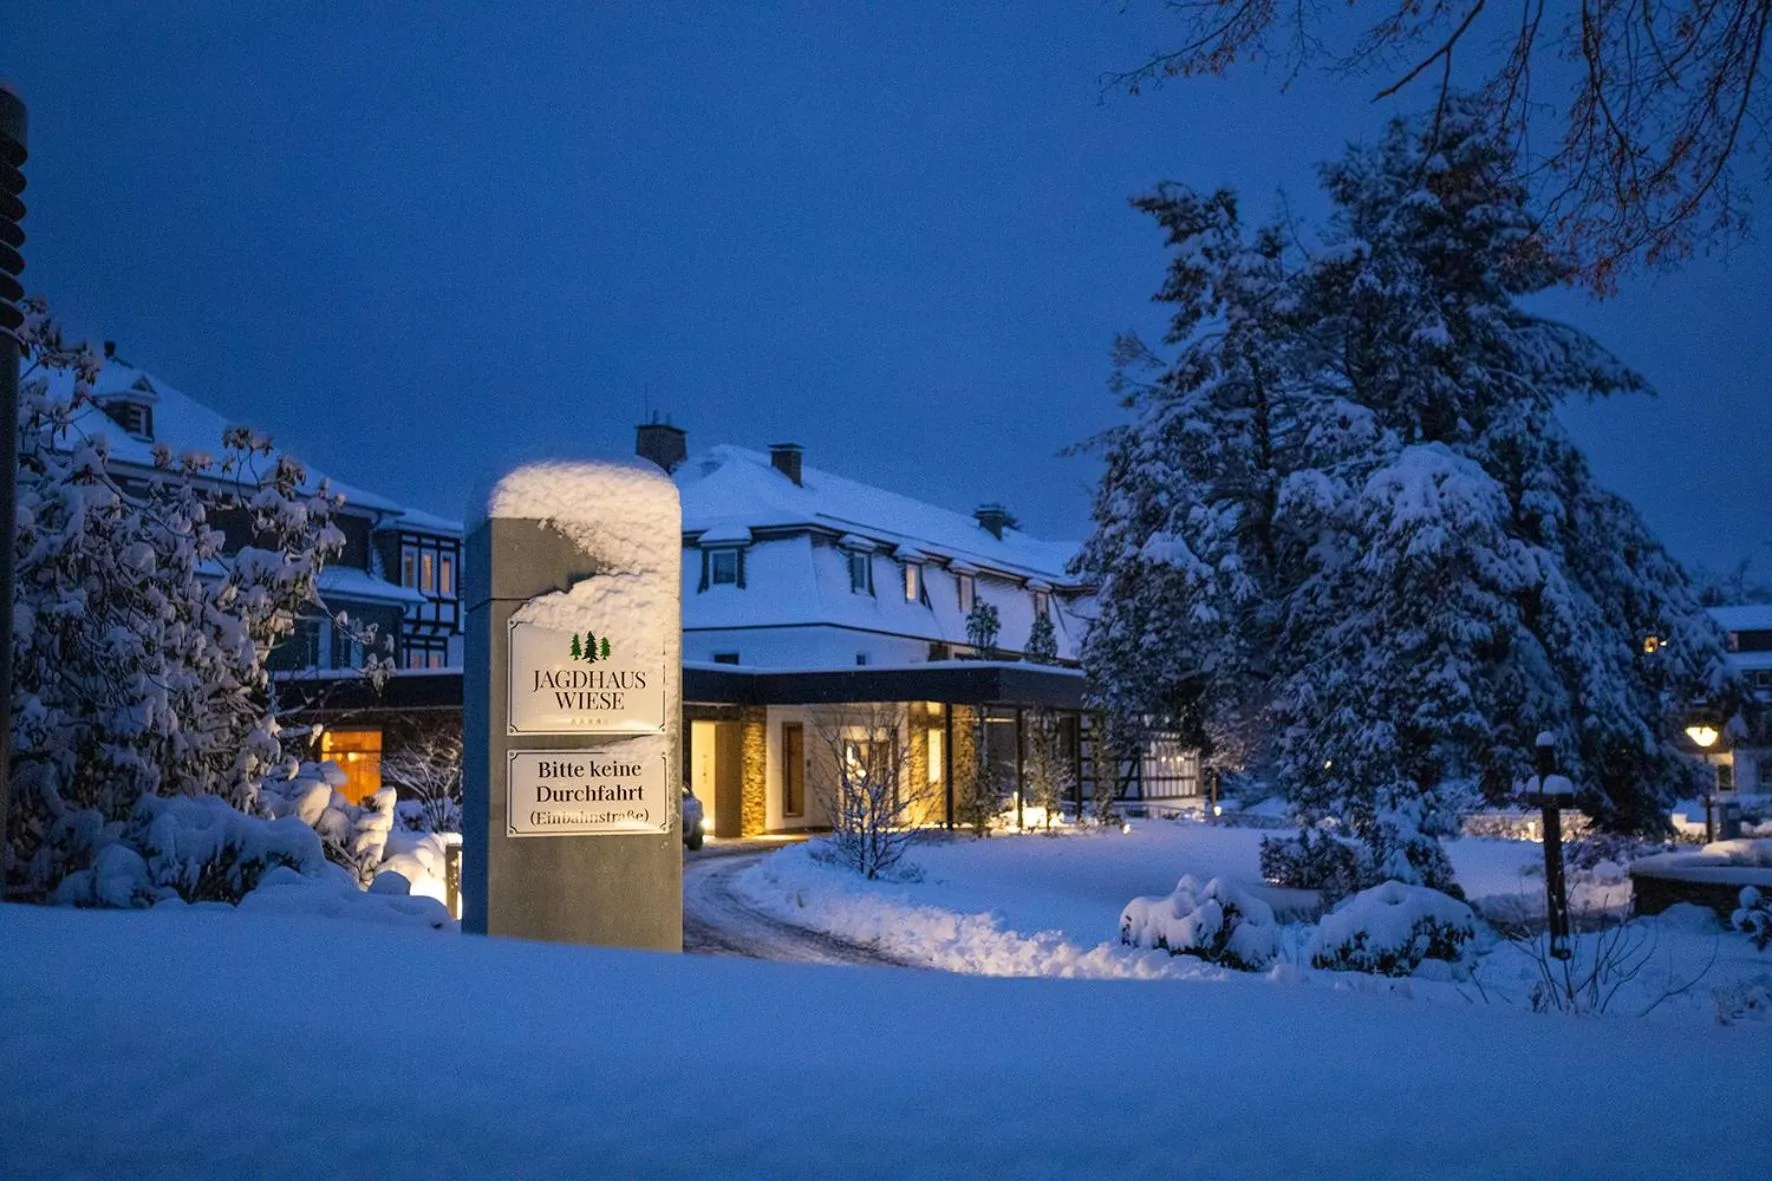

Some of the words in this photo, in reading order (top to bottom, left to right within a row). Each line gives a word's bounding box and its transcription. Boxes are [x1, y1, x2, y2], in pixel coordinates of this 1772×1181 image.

[533, 670, 646, 692] JAGDHAUS
[555, 691, 625, 710] WIESE
[538, 761, 584, 778] Bitte
[590, 760, 642, 777] keine
[536, 785, 645, 802] Durchfahrt
